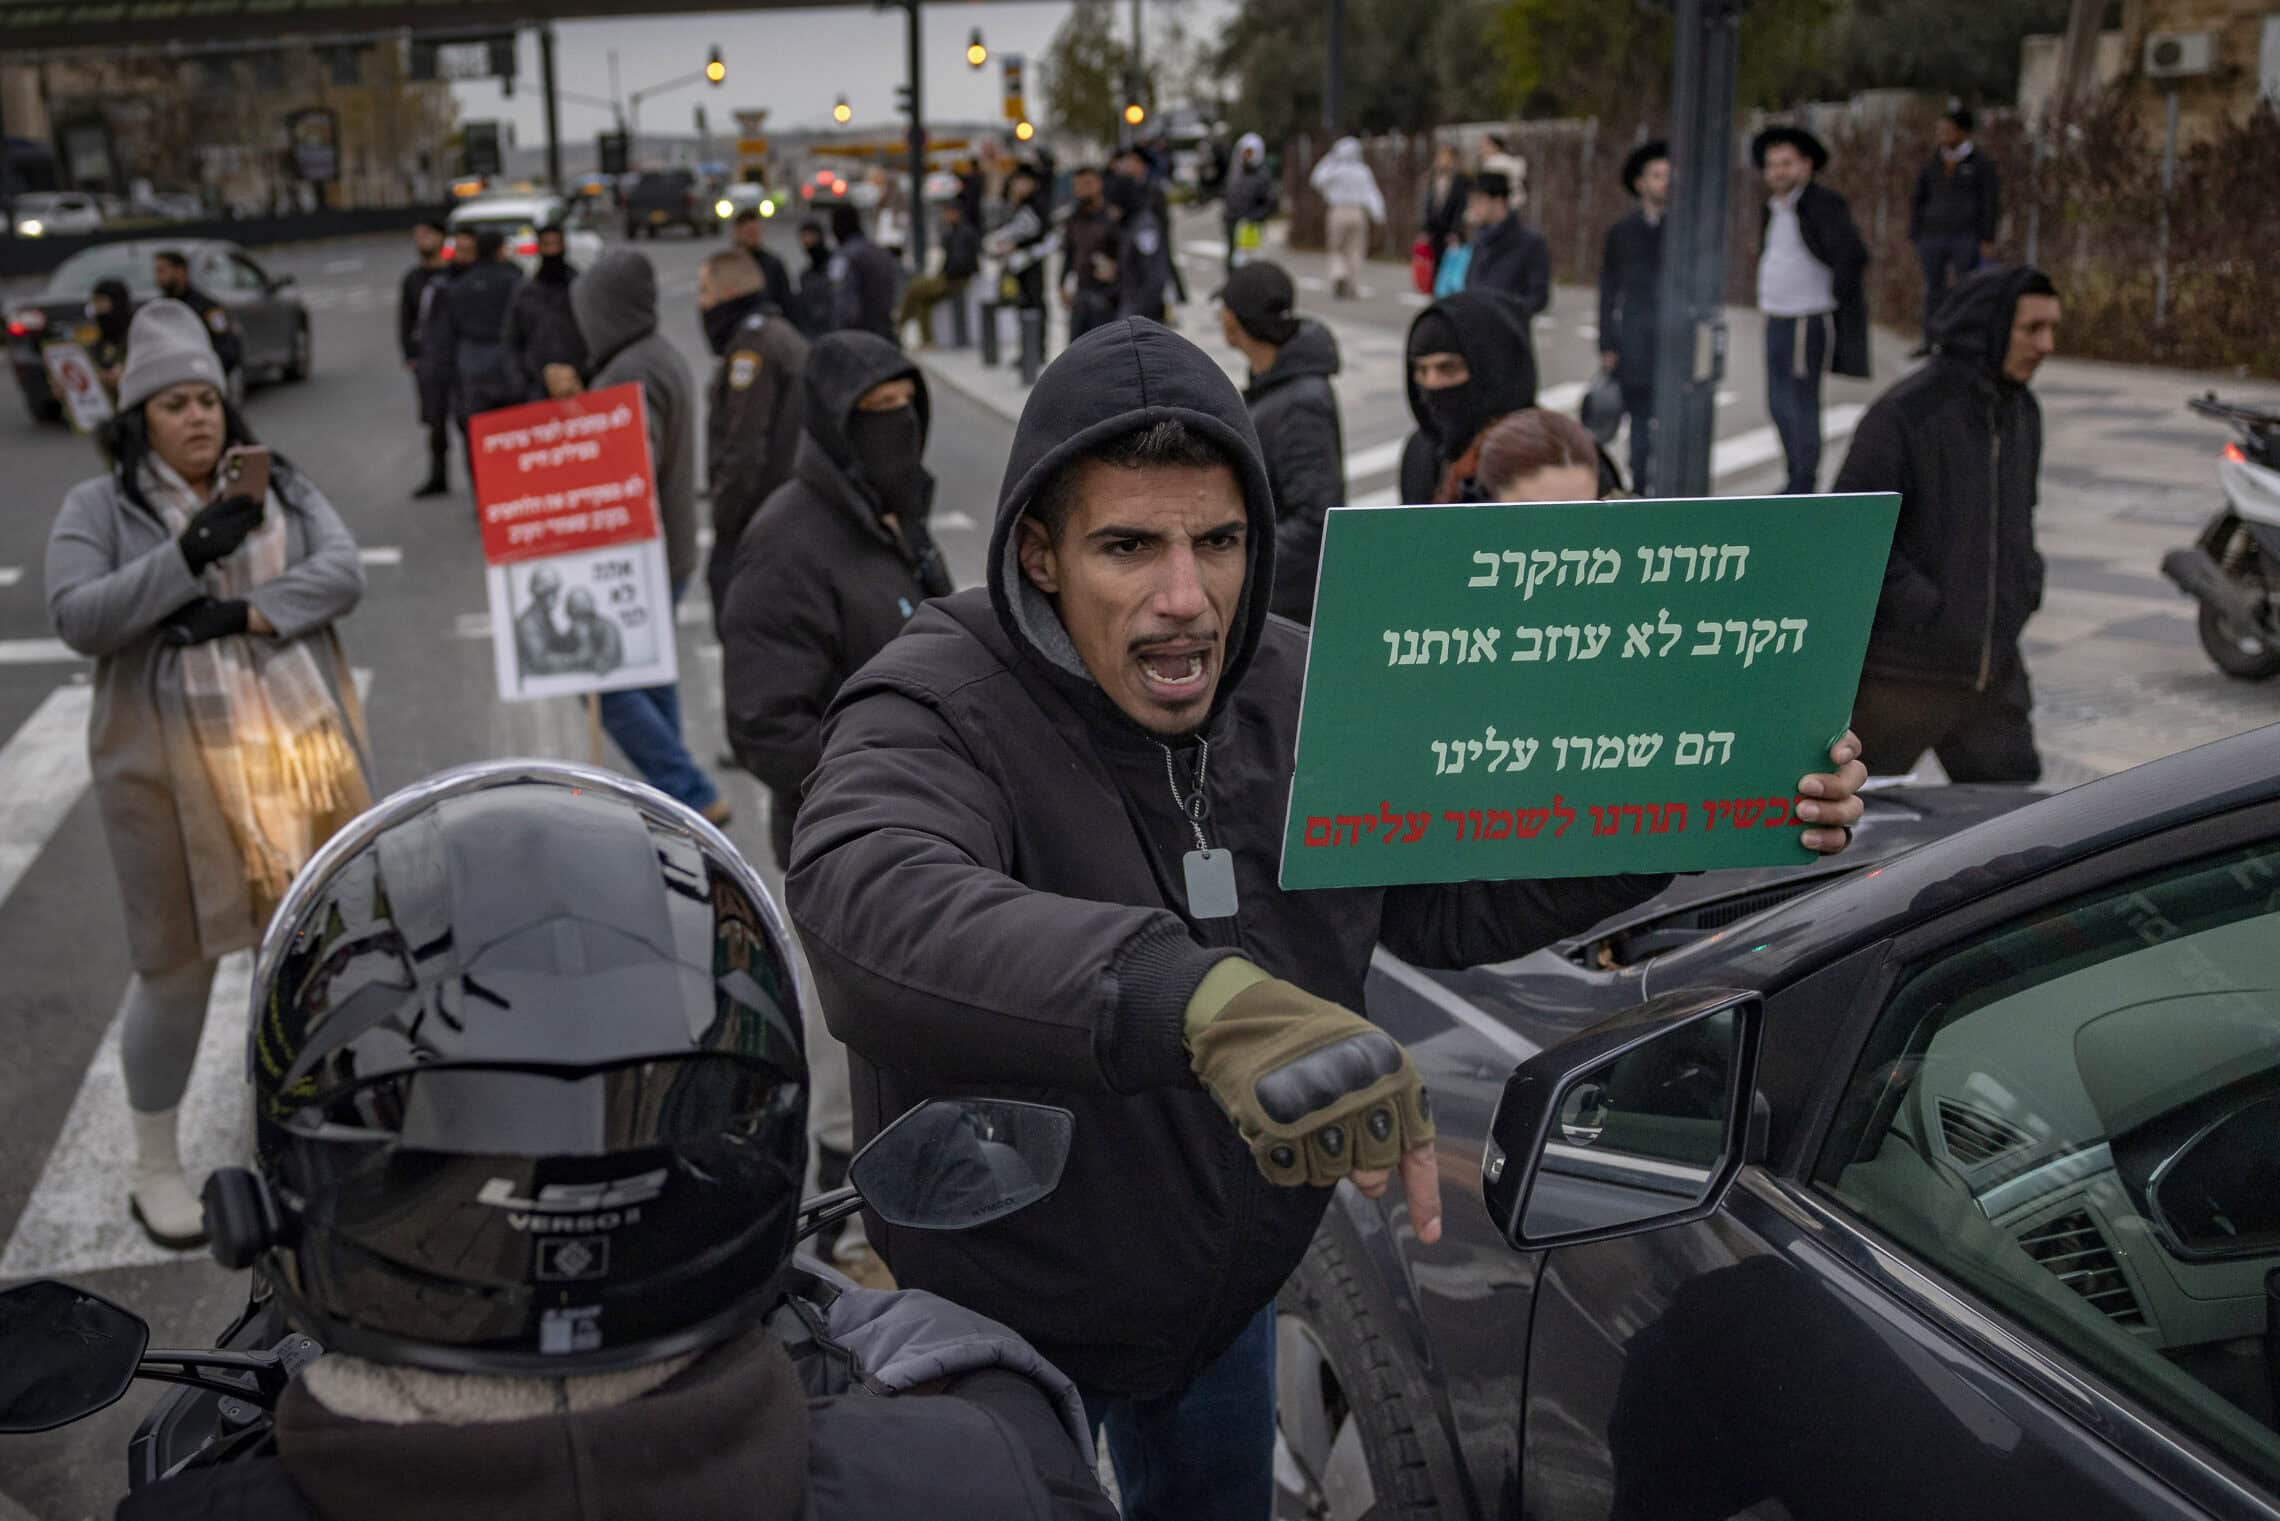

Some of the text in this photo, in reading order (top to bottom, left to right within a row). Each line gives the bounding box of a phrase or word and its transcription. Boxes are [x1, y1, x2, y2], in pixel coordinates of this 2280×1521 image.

[1467, 544, 1750, 601] חזרנו מהקרב
[1383, 607, 1808, 669] הקרב לא עוזב אותנו
[1431, 725, 1735, 776] הם שמרו עלינו
[1304, 800, 1432, 847] עליהם
[1444, 794, 1576, 841] לשמור
[1588, 802, 1688, 837] תורנו
[507, 1213, 620, 1233] VERSO
